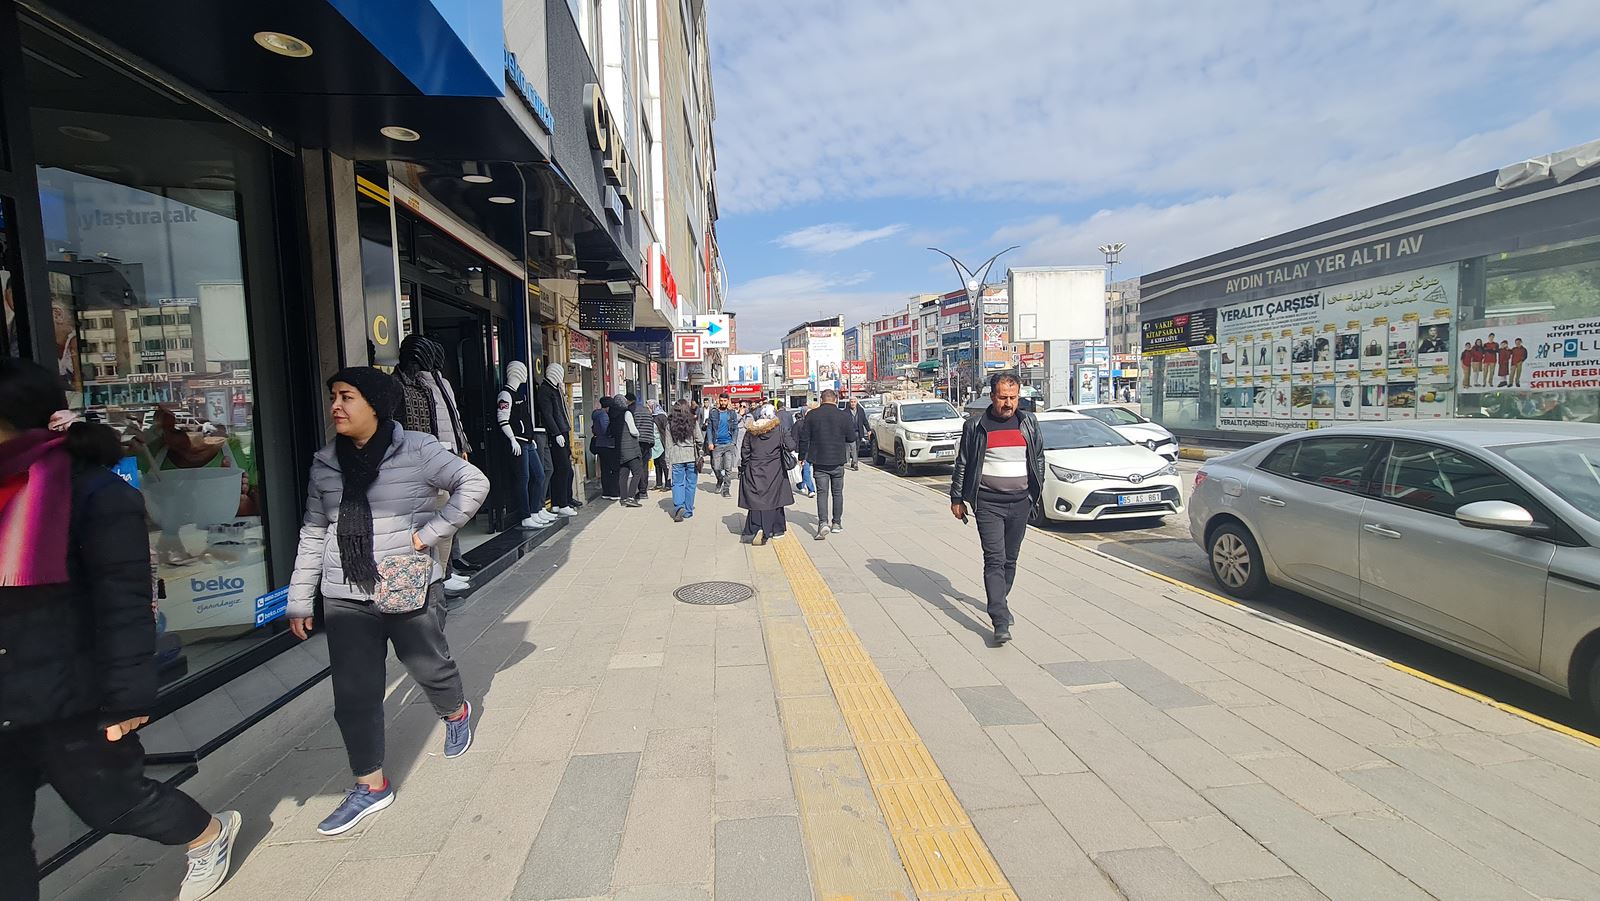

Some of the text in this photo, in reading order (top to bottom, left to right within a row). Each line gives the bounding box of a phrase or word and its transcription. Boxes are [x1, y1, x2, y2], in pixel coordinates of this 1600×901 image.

[1226, 234, 1424, 293] AYDIN TALAY YER ALTI AV
[1221, 294, 1320, 322] YERALTI ÇARŞISI
[1154, 320, 1174, 330] VAKIF
[681, 338, 696, 357] E
[1532, 368, 1600, 378] AKTİF BEB
[1220, 419, 1242, 427] YERALTI
[190, 575, 245, 592] beko
